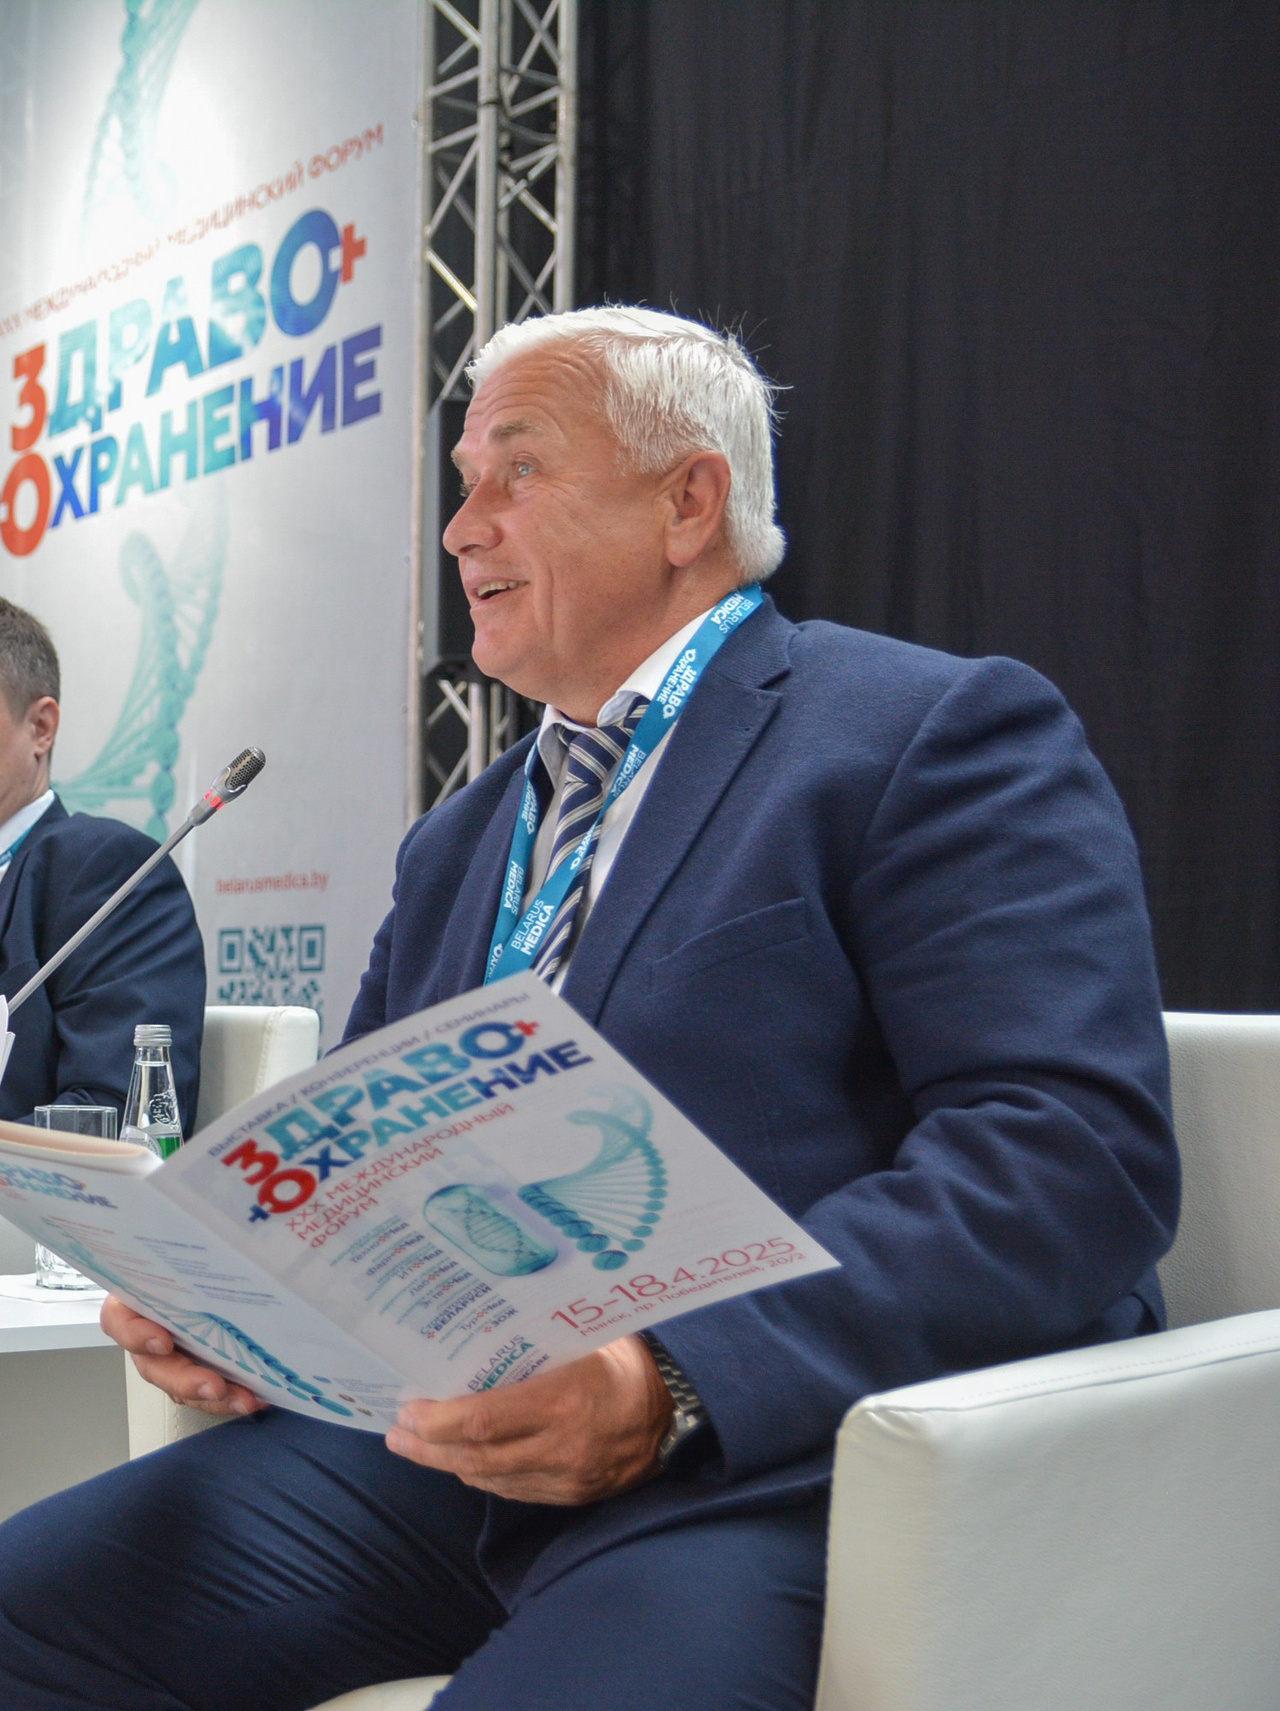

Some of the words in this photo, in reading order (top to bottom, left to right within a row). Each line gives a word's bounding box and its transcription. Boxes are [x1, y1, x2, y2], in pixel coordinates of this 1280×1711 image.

[710, 592, 745, 625] MEDICA
[719, 599, 754, 634] BELARUS
[503, 860, 519, 909] MEDICA
[510, 899, 544, 951] BELARUS
[520, 904, 555, 956] MEDICA
[209, 1101, 291, 1157] ВЫСТАВКА
[299, 1035, 420, 1095] КОНФЕРЕНЦИИ
[325, 1101, 515, 1199] МЕЖДУНАРОДНЫЙ
[297, 1147, 444, 1242] МЕДИЦИНСКИЙ
[309, 1195, 380, 1249] ФОРУМ
[467, 1334, 525, 1391] BELARUS
